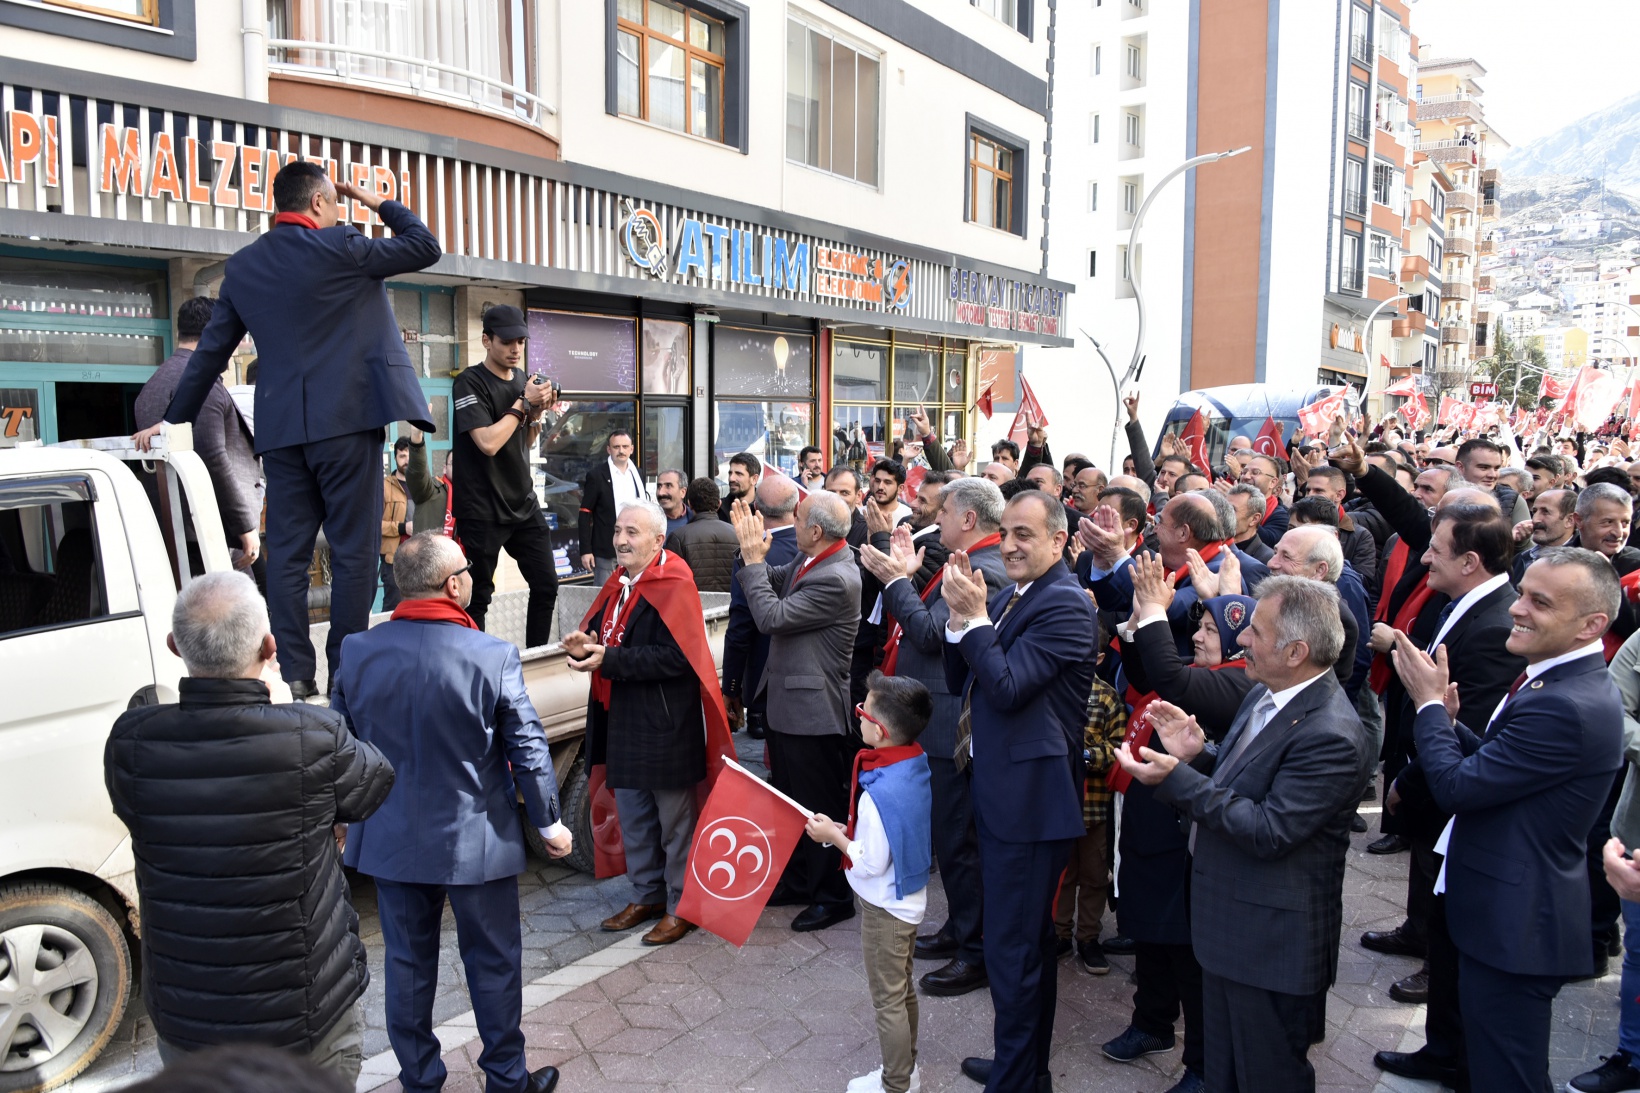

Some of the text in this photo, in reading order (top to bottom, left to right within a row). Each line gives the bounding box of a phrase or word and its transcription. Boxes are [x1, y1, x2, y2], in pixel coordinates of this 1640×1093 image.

[677, 218, 808, 293] ATILIM
[950, 267, 1007, 308] BERKAY
[956, 301, 986, 326] MOTORLU
